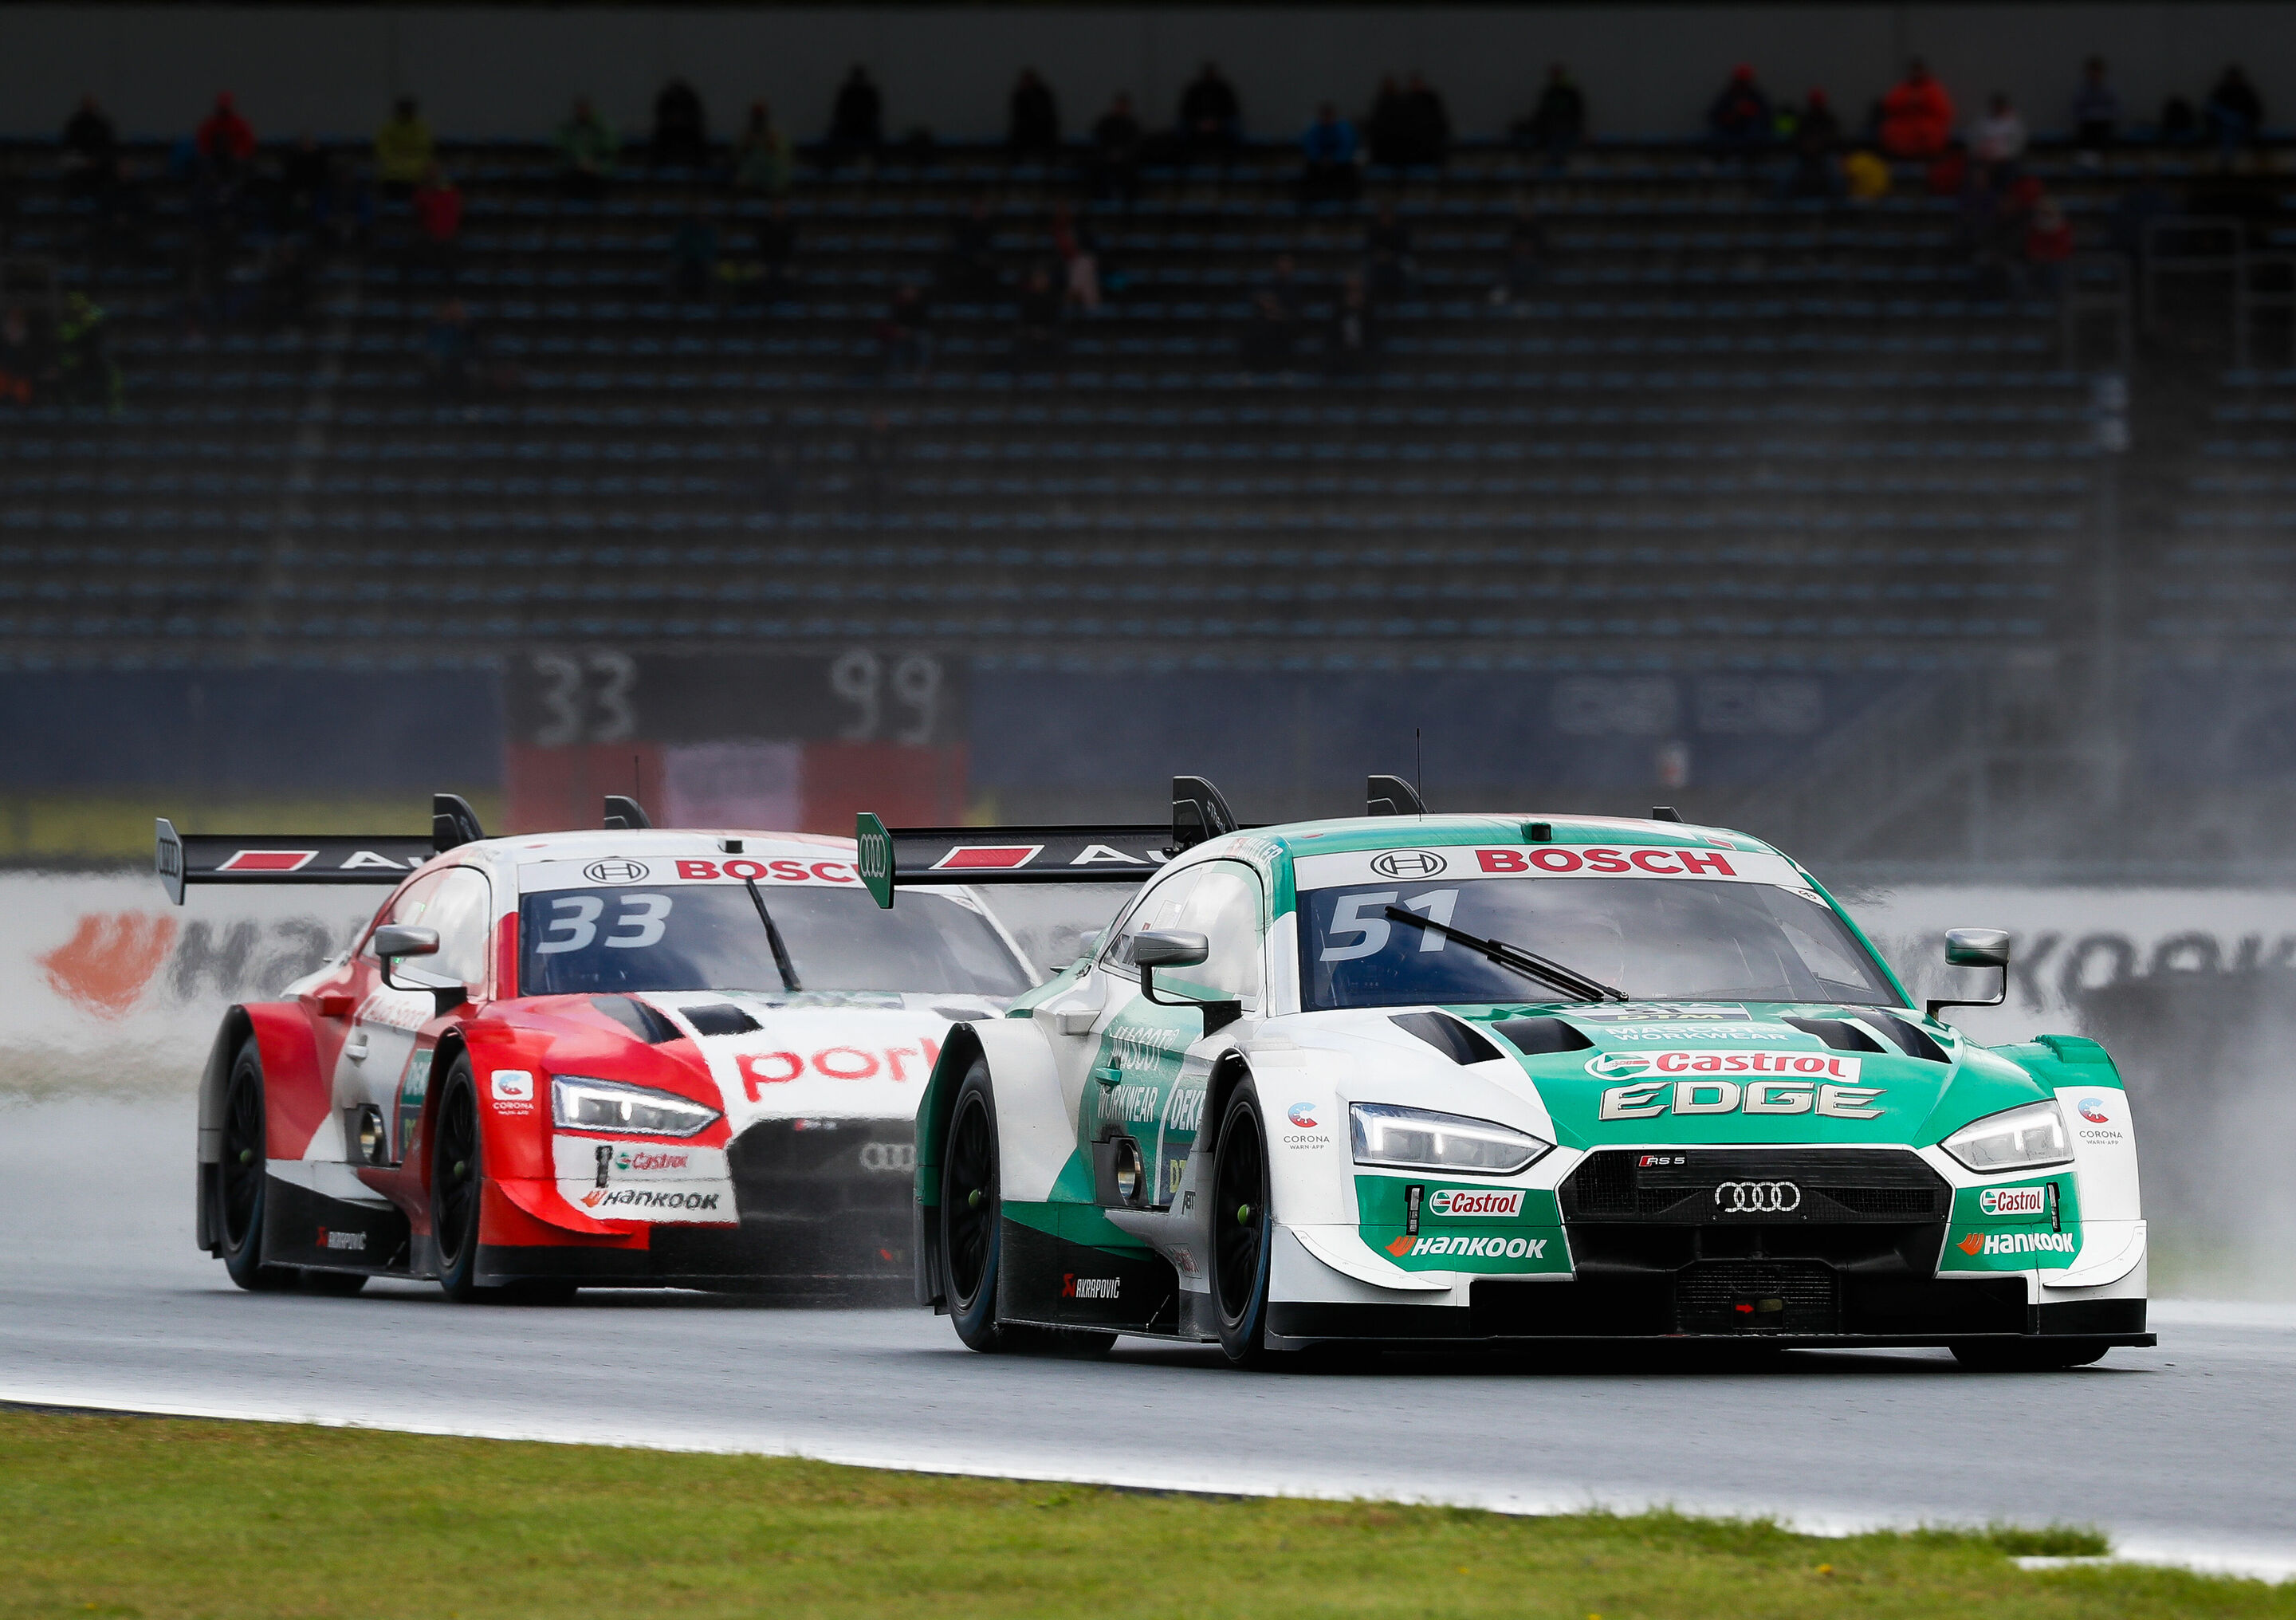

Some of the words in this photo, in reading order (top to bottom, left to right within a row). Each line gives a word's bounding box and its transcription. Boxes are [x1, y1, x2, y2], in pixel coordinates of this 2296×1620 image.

[533, 652, 636, 744] 33
[829, 650, 942, 745] 99
[674, 859, 856, 883] BOSC
[1475, 848, 1737, 876] BOSCH
[536, 894, 673, 954] 33
[1319, 889, 1460, 961] 51
[1656, 1052, 1846, 1077] Castrol
[1598, 1080, 1888, 1121] EDGE
[1451, 1193, 1518, 1213] Castrol
[1997, 1190, 2042, 1211] Castrol
